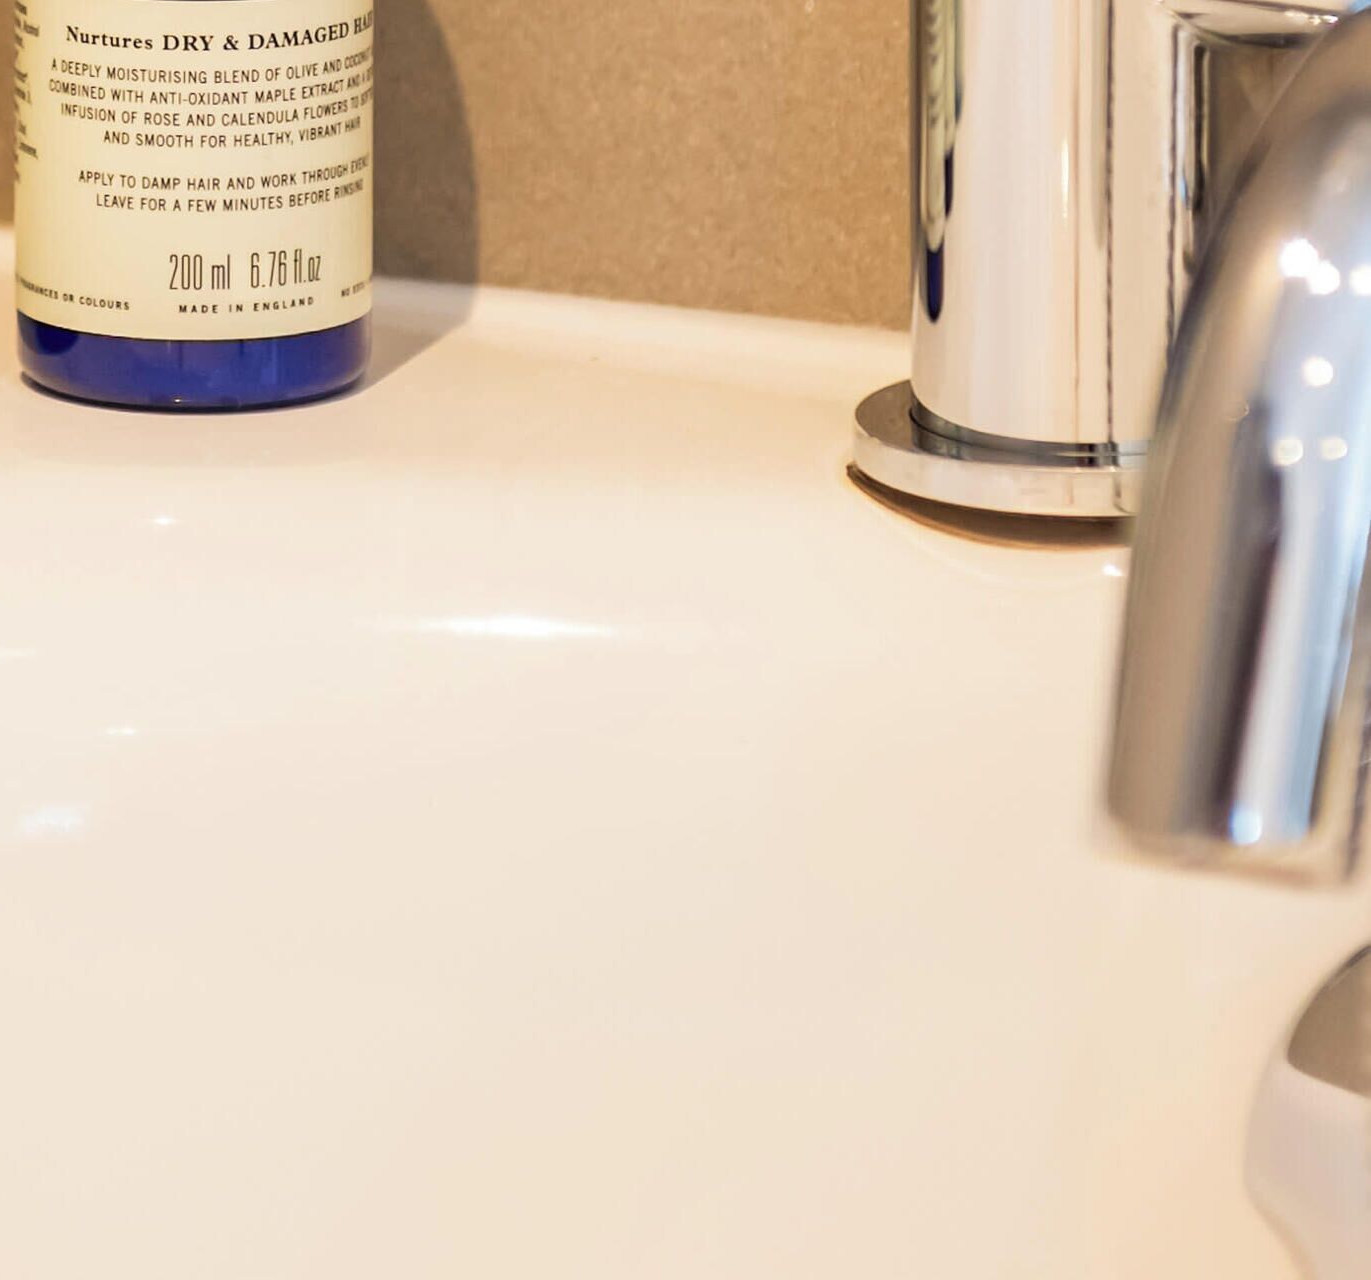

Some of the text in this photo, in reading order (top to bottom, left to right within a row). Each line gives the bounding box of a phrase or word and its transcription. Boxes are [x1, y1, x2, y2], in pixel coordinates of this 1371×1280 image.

[66, 21, 349, 51] Nurtures DRY & DAMAGED
[52, 59, 57, 70] A
[61, 60, 100, 78] DEEPLY
[107, 67, 207, 84] MOISTURISING
[214, 69, 260, 84] BLEND
[265, 68, 281, 82] OF
[286, 63, 318, 80] OLIVE
[323, 59, 342, 76] AND
[49, 79, 105, 100] COMBINED
[111, 88, 143, 103] WITH
[150, 92, 247, 106] ANTI-OXIDANT
[255, 88, 296, 103] MAPLE
[302, 81, 344, 100] EXTRACT
[61, 101, 347, 127] INFUSION OF ROSE AND CALENDULA FLOWERS
[104, 122, 341, 148] AND SMOOTH FOR HEALTHY, VIBRANT
[79, 161, 348, 191] APPLY TO DAMP HAIR AND WORK THROUGH
[96, 188, 331, 212] LEAVE FOR A FEW MINUTES BEFORE
[169, 249, 321, 290] 200 ml 6.76 fl.oz
[79, 296, 130, 310] COLOURS
[179, 297, 314, 313] MADE IN ENGLAND
